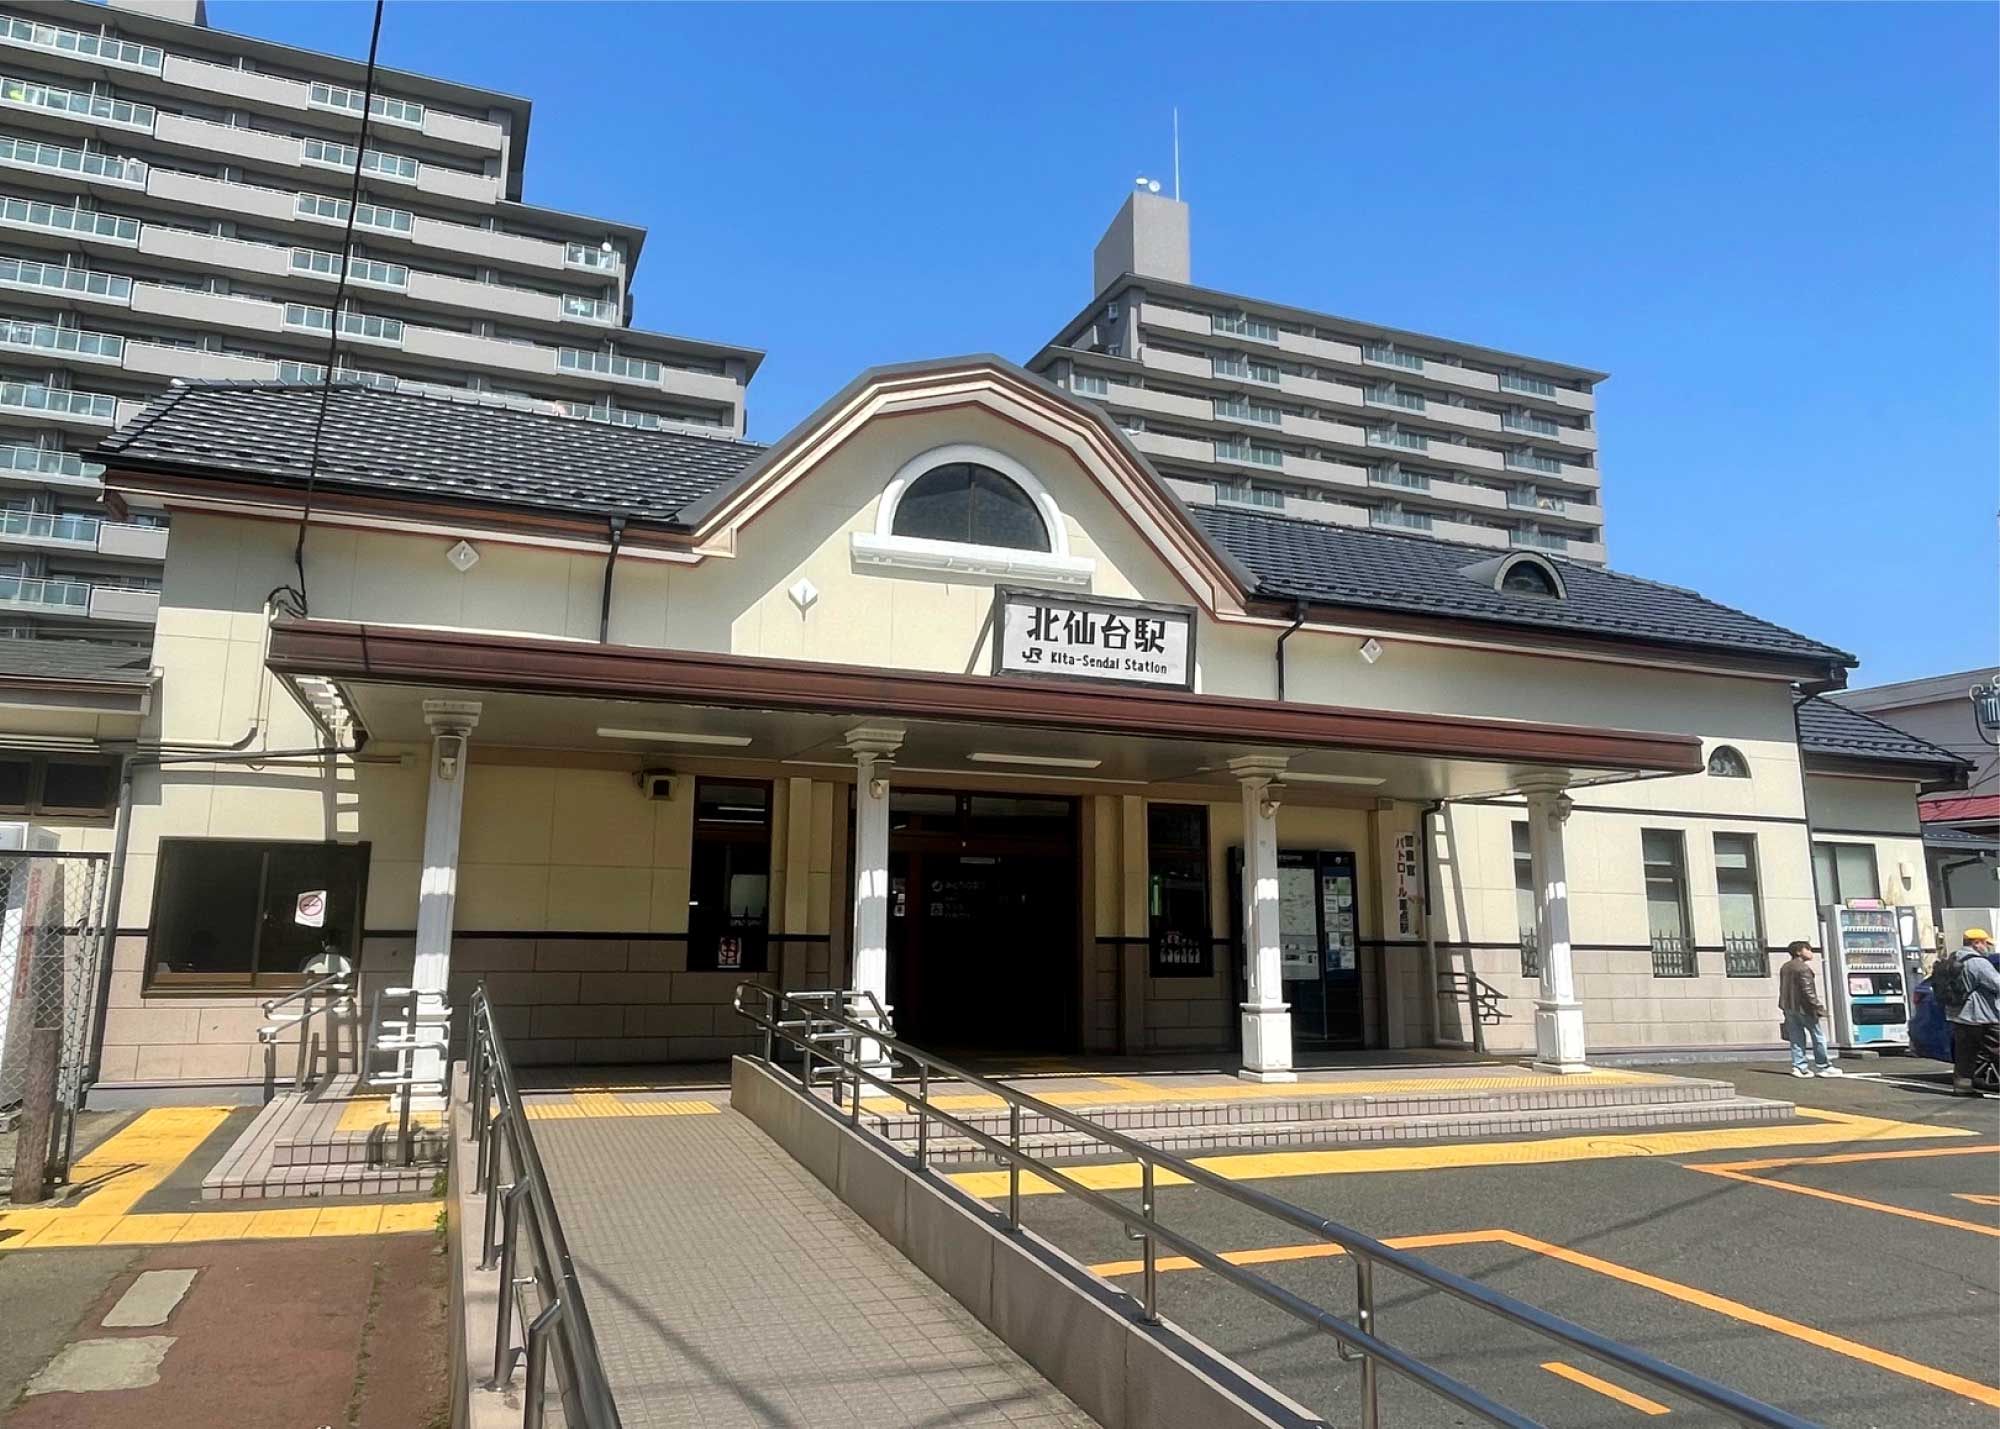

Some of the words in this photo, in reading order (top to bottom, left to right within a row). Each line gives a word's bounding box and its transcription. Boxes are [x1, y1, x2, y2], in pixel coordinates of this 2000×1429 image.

[1026, 606, 1165, 653] 北仙台駅
[1022, 647, 1042, 662] JR
[1051, 652, 1119, 669] Kita-Sendai
[1124, 658, 1167, 674] Station
